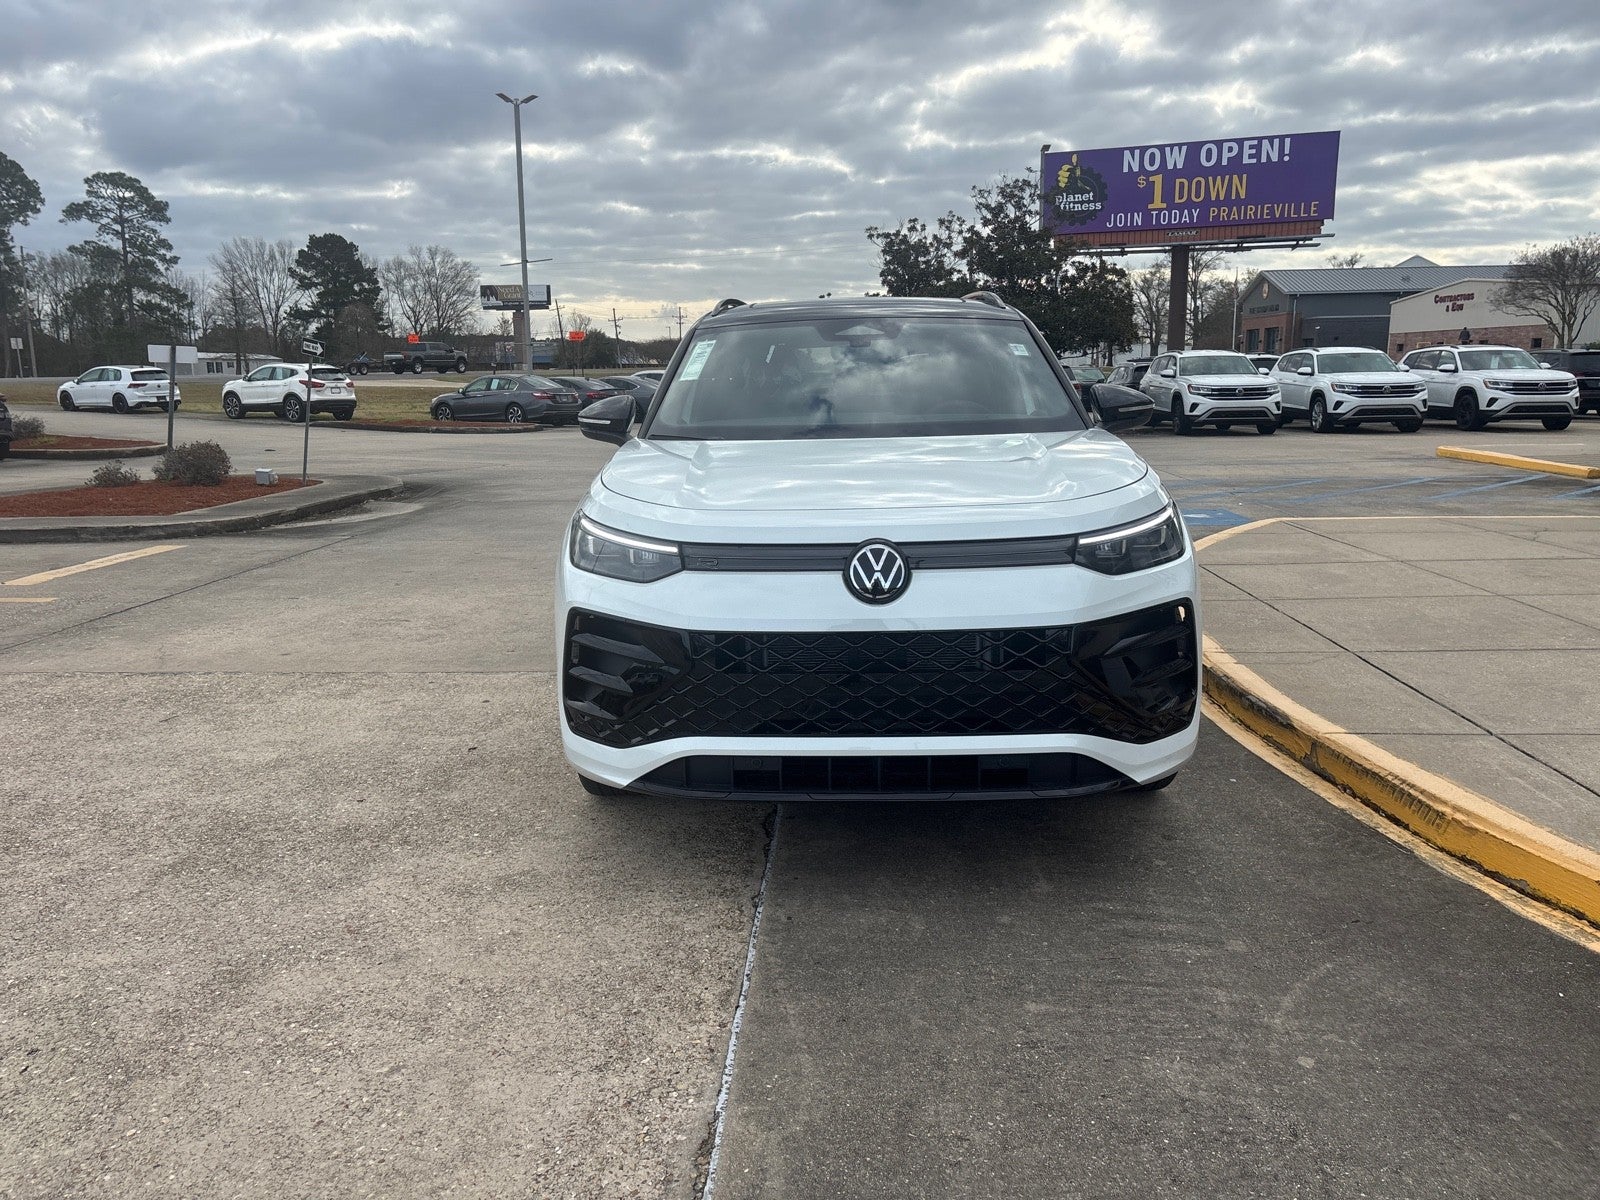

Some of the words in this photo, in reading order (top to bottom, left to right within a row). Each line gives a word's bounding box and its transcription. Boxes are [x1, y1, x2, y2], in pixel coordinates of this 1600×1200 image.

[1122, 145, 1187, 173] NOW
[1200, 137, 1291, 167] OPEN!
[1055, 191, 1094, 206] planet
[1137, 173, 1167, 209] $1
[1174, 173, 1247, 204] DOWN
[1060, 201, 1102, 212] fitness
[1106, 212, 1142, 228] JOIN
[1151, 208, 1200, 226] TODAY
[1209, 201, 1319, 222] PRAIRIEVILLE
